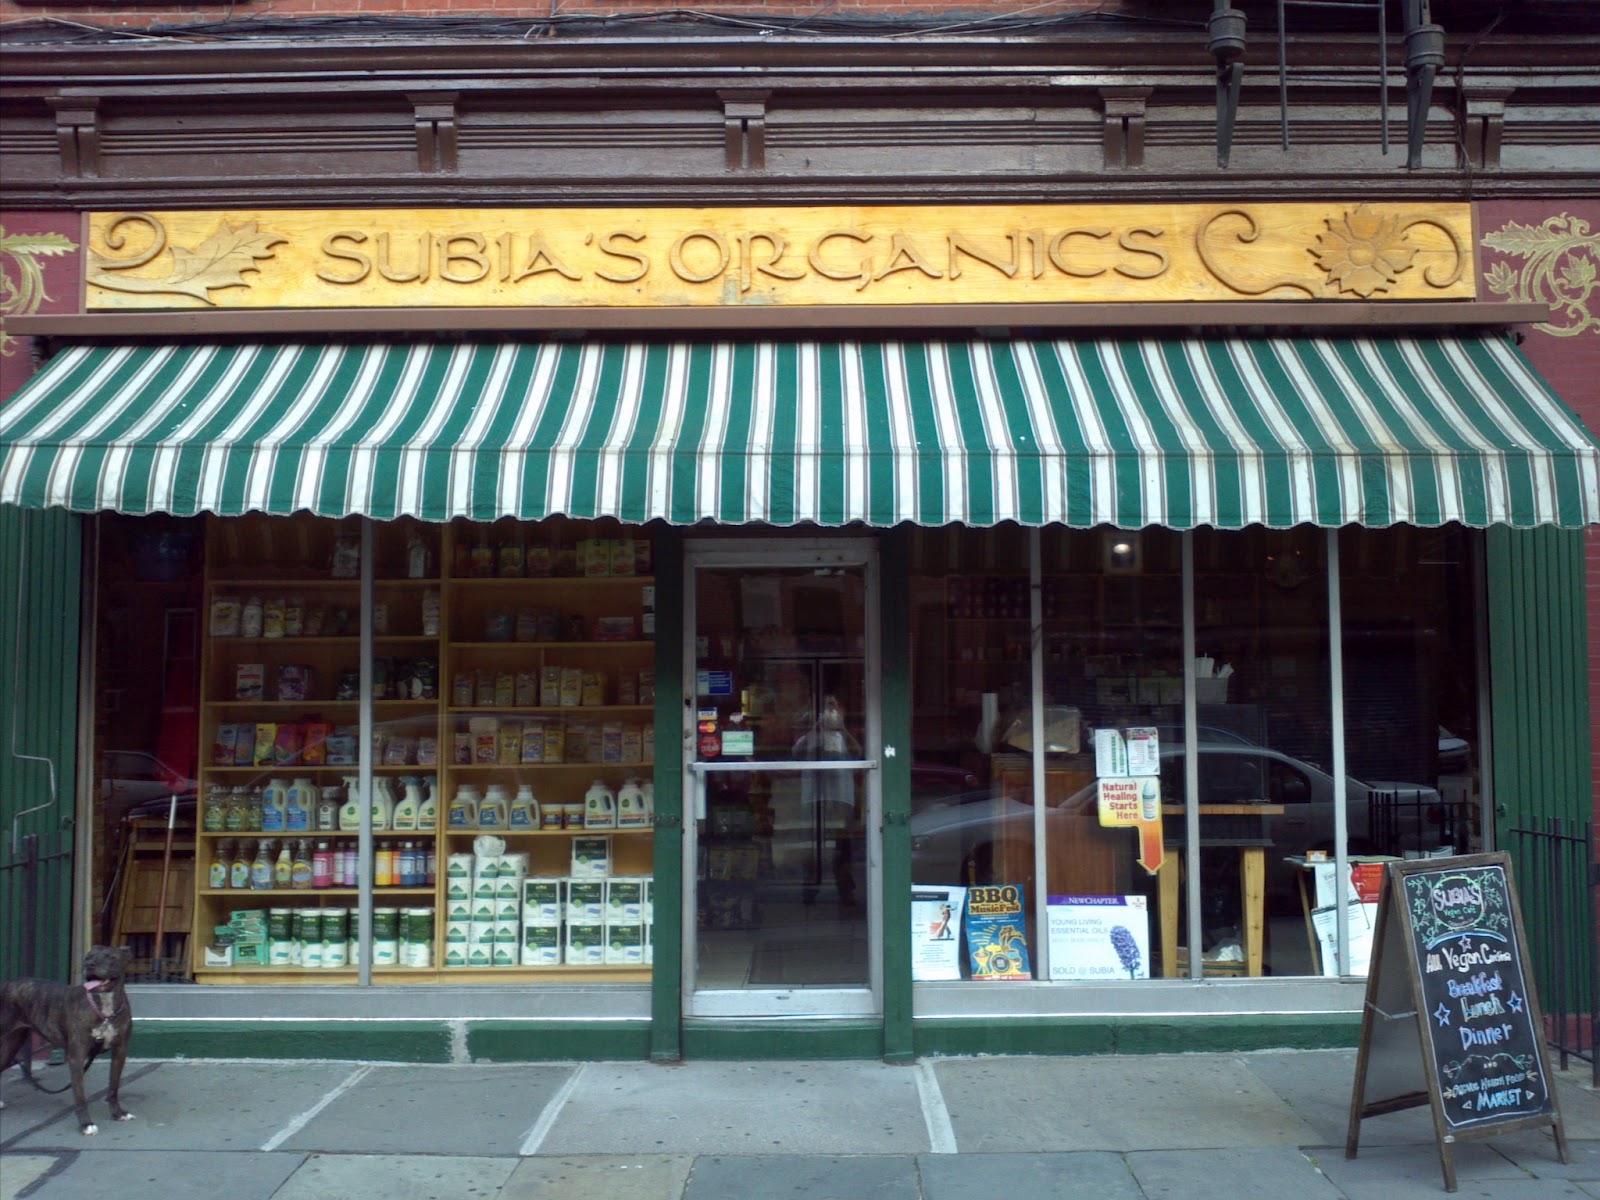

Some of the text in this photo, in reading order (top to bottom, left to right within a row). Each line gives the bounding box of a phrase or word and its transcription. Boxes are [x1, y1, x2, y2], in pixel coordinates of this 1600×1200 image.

[317, 230, 1170, 292] SUBIA'S ORGANICS
[1102, 782, 1137, 791] Natural
[1103, 792, 1137, 801] Healing
[1109, 802, 1138, 811] Starts
[1116, 811, 1138, 820] Here
[970, 887, 1018, 905] BBQ
[1433, 885, 1480, 911] SUBIA'S
[1052, 966, 1115, 975] SOLD @ SUBIA
[1442, 947, 1483, 972] Vegan
[1447, 970, 1503, 998] Breakfast
[1460, 993, 1505, 1022] Lunch
[1459, 1022, 1512, 1051] Dinner
[1476, 1087, 1522, 1112] MARKET
